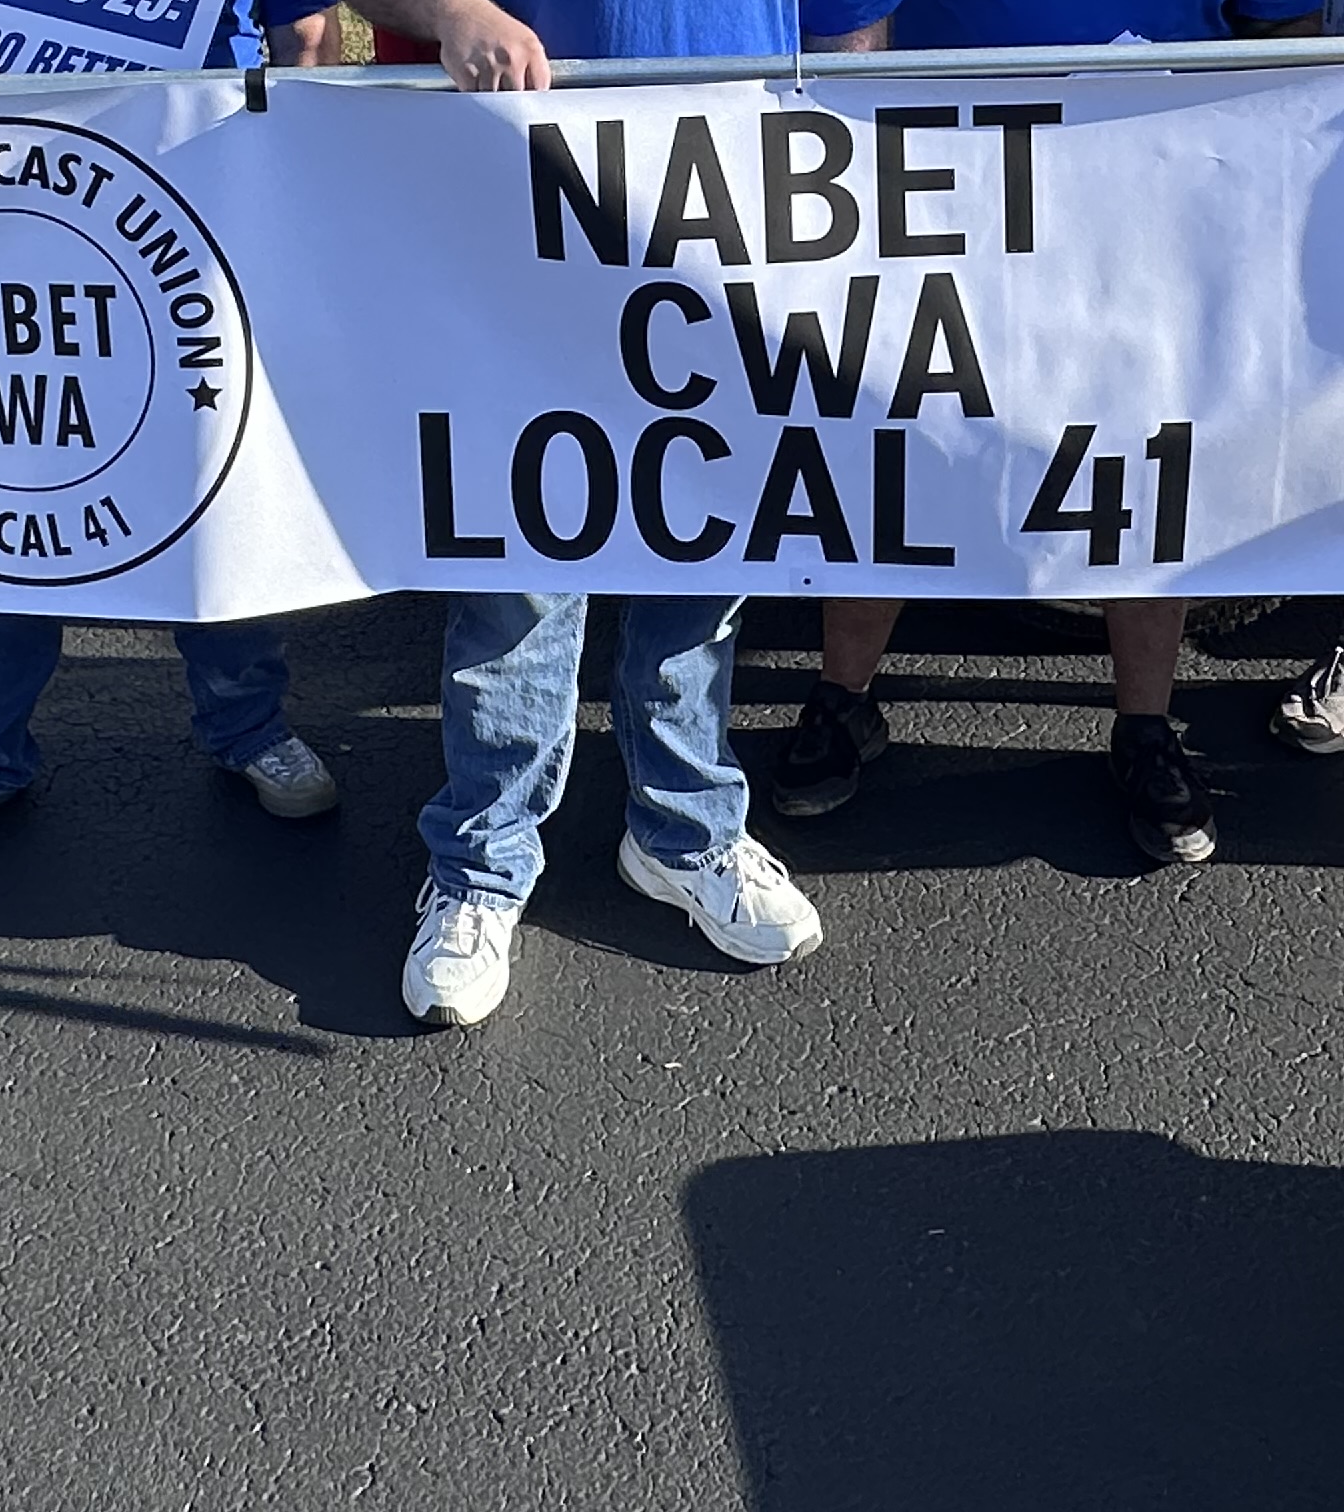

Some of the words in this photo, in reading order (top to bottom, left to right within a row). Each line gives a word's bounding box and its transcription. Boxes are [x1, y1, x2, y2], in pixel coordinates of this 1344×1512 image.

[529, 103, 1064, 268] NABET
[115, 193, 224, 369] UNION
[619, 273, 995, 421] CWA
[83, 495, 133, 549] 41
[419, 410, 956, 568] LOCAL
[1020, 422, 1194, 567] 41
